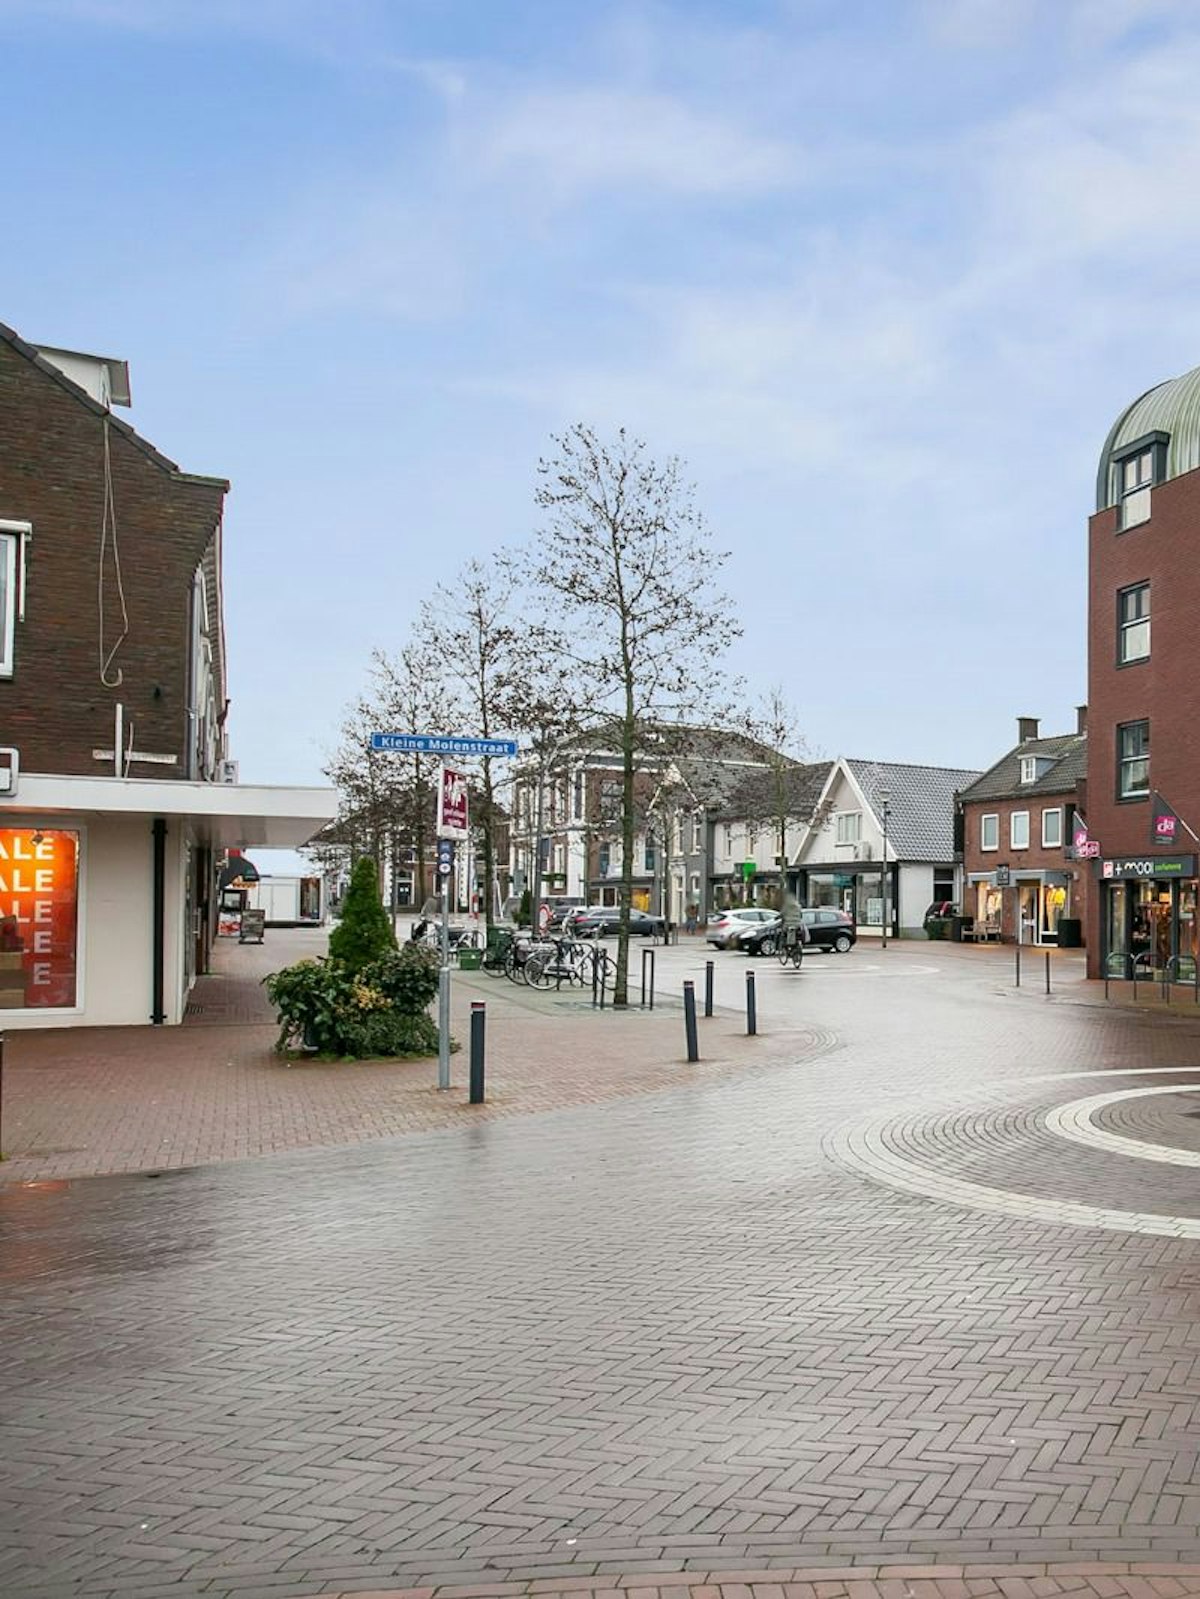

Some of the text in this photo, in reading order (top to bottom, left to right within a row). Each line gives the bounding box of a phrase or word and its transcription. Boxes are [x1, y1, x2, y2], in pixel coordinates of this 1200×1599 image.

[381, 737, 509, 753] Kleine Molenstraat
[1157, 819, 1176, 833] da
